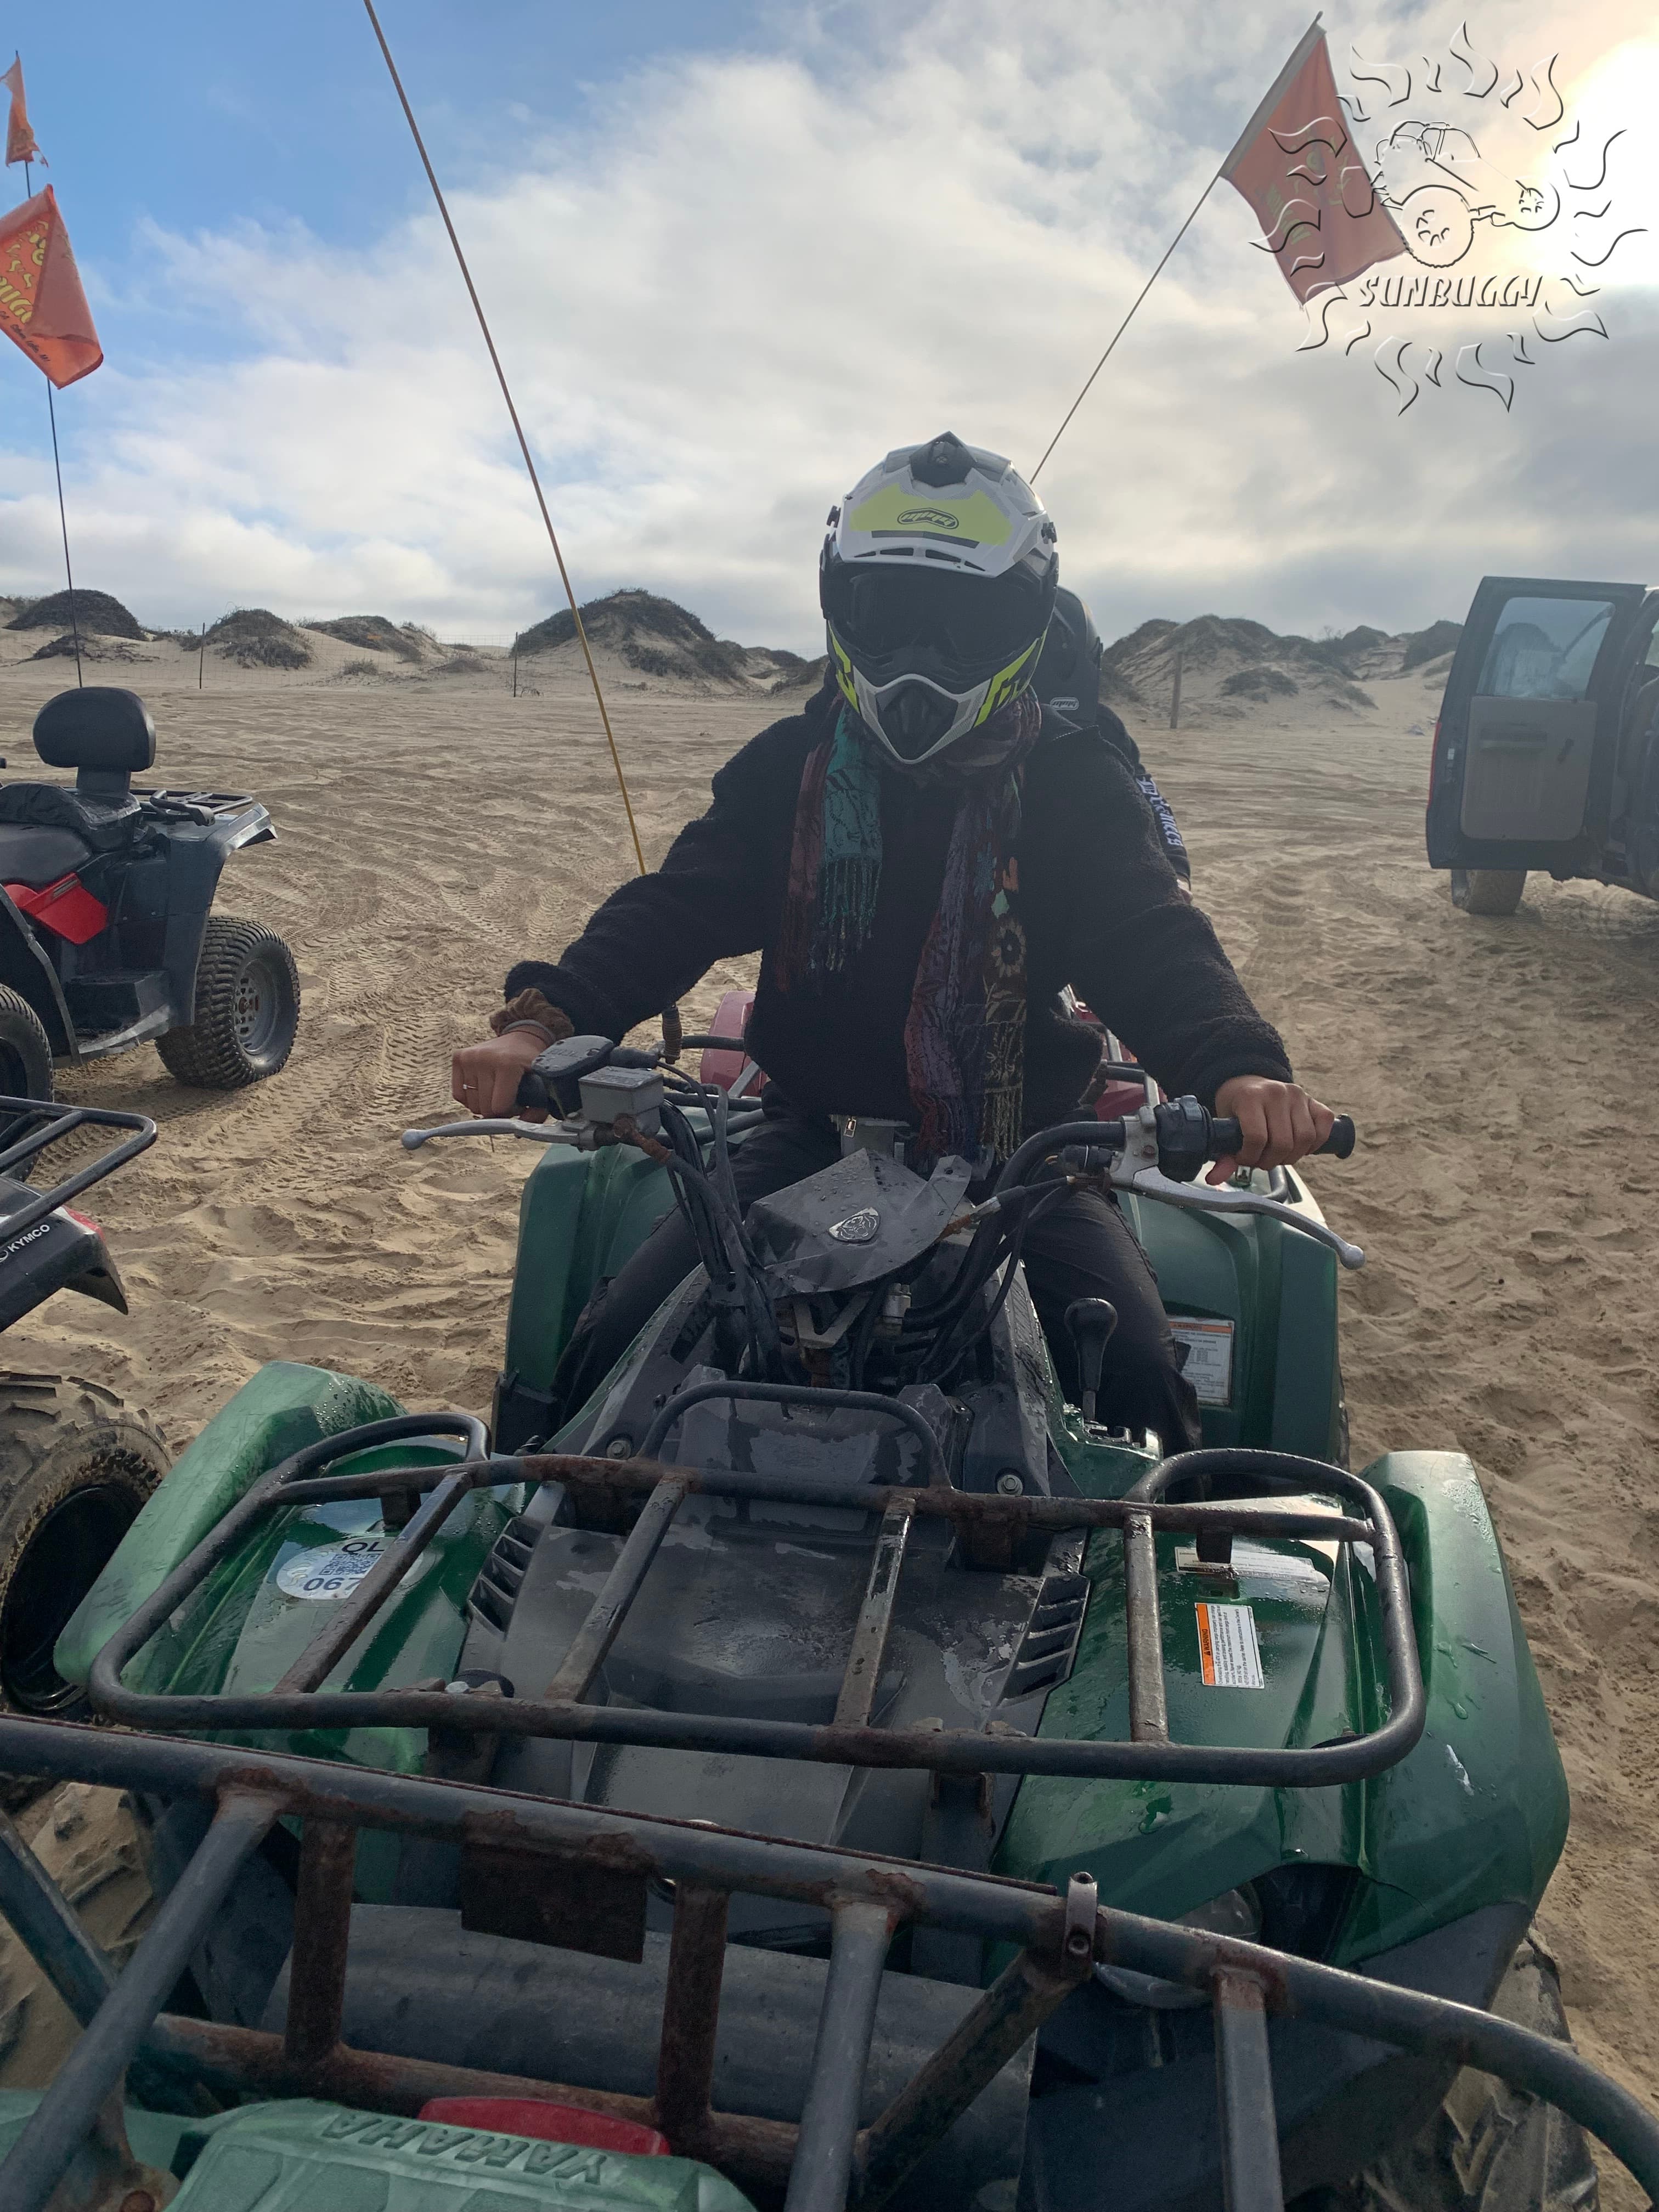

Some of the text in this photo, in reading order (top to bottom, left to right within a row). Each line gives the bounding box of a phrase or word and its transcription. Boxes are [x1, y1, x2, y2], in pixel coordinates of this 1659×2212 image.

[7, 1224, 50, 1252] KYMCO
[1201, 1629, 1210, 1650] WARNING
[320, 2113, 607, 2185] YAMAHA
